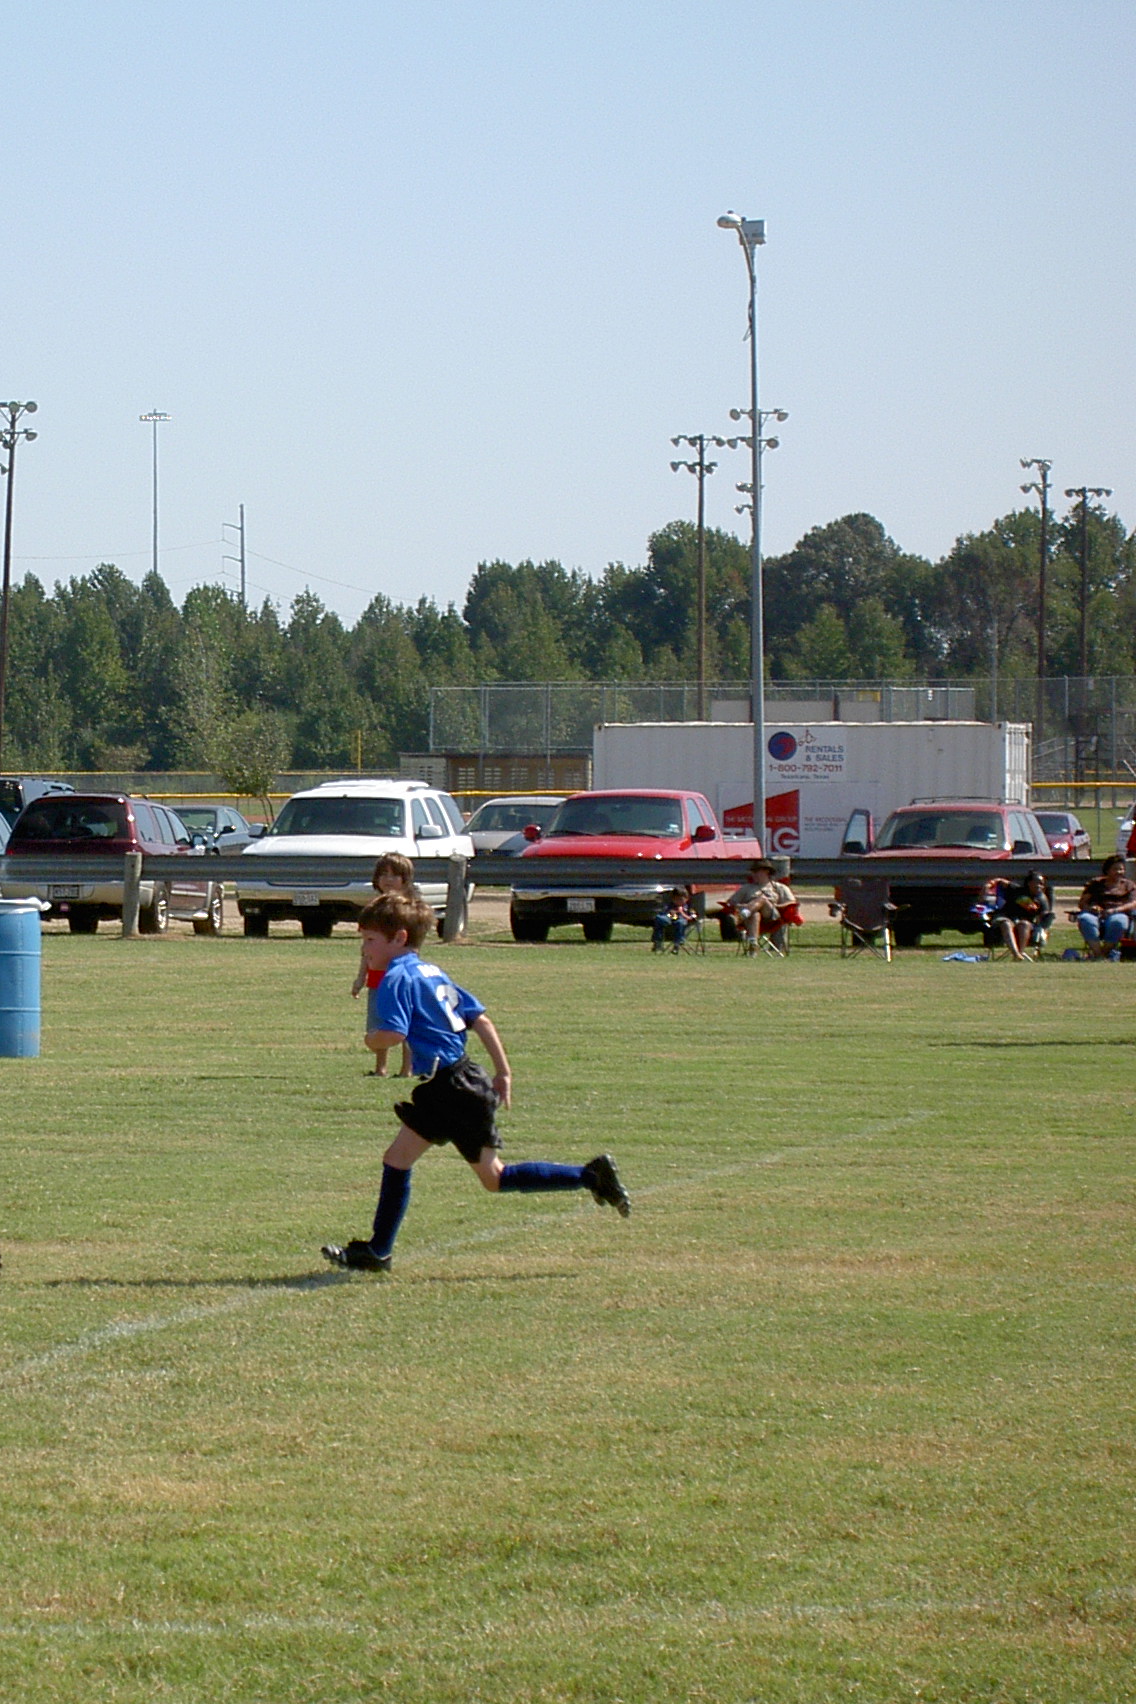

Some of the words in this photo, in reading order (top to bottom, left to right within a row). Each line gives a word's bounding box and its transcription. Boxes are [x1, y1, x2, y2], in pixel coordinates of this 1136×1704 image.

[805, 745, 844, 753] RENTALS
[815, 754, 844, 762] SALES
[436, 984, 467, 1033] 2
